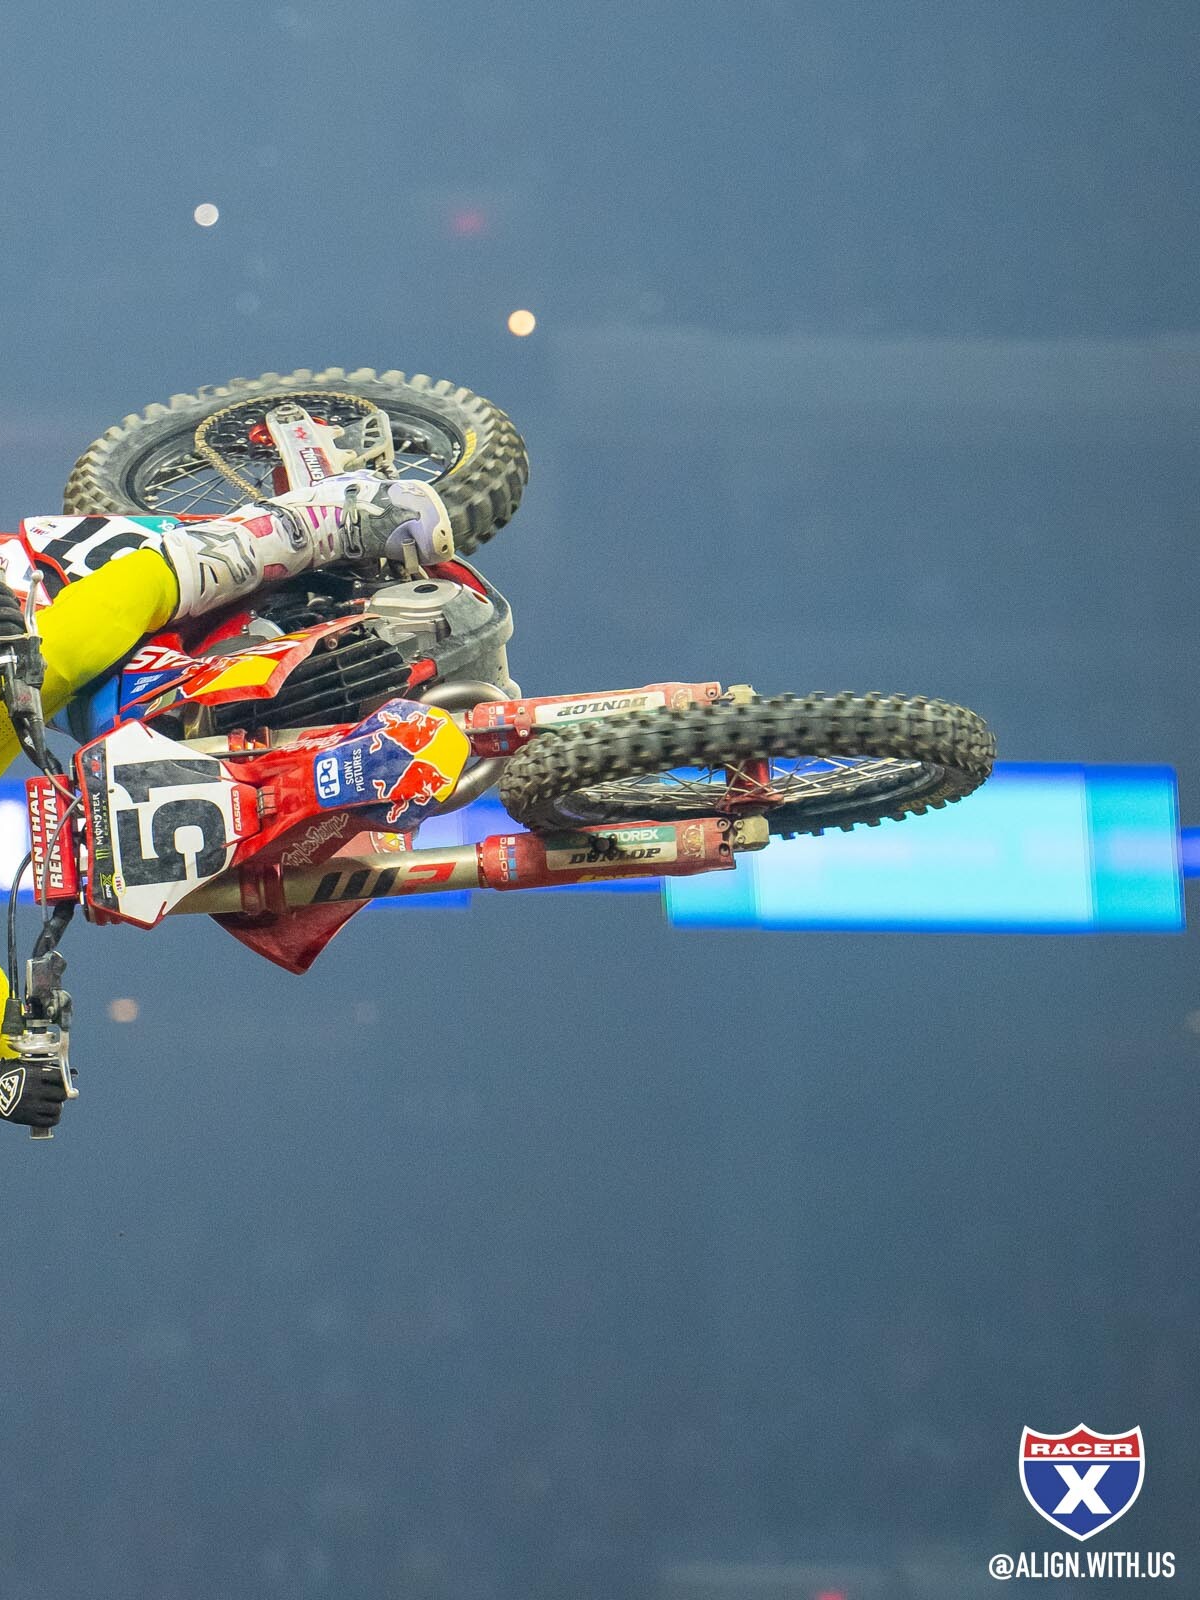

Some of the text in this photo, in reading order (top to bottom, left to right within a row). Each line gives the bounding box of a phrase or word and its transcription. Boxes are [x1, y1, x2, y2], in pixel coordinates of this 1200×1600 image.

[301, 447, 326, 487] ENTHAL
[557, 696, 648, 717] DUNLOP
[345, 760, 354, 785] SONY
[354, 748, 365, 792] PICTURES
[113, 759, 228, 887] 51
[231, 789, 243, 832] GASGAS
[29, 785, 44, 890] RENTHAL
[42, 785, 64, 888] RENTHAL
[569, 847, 661, 866] DUNLOP
